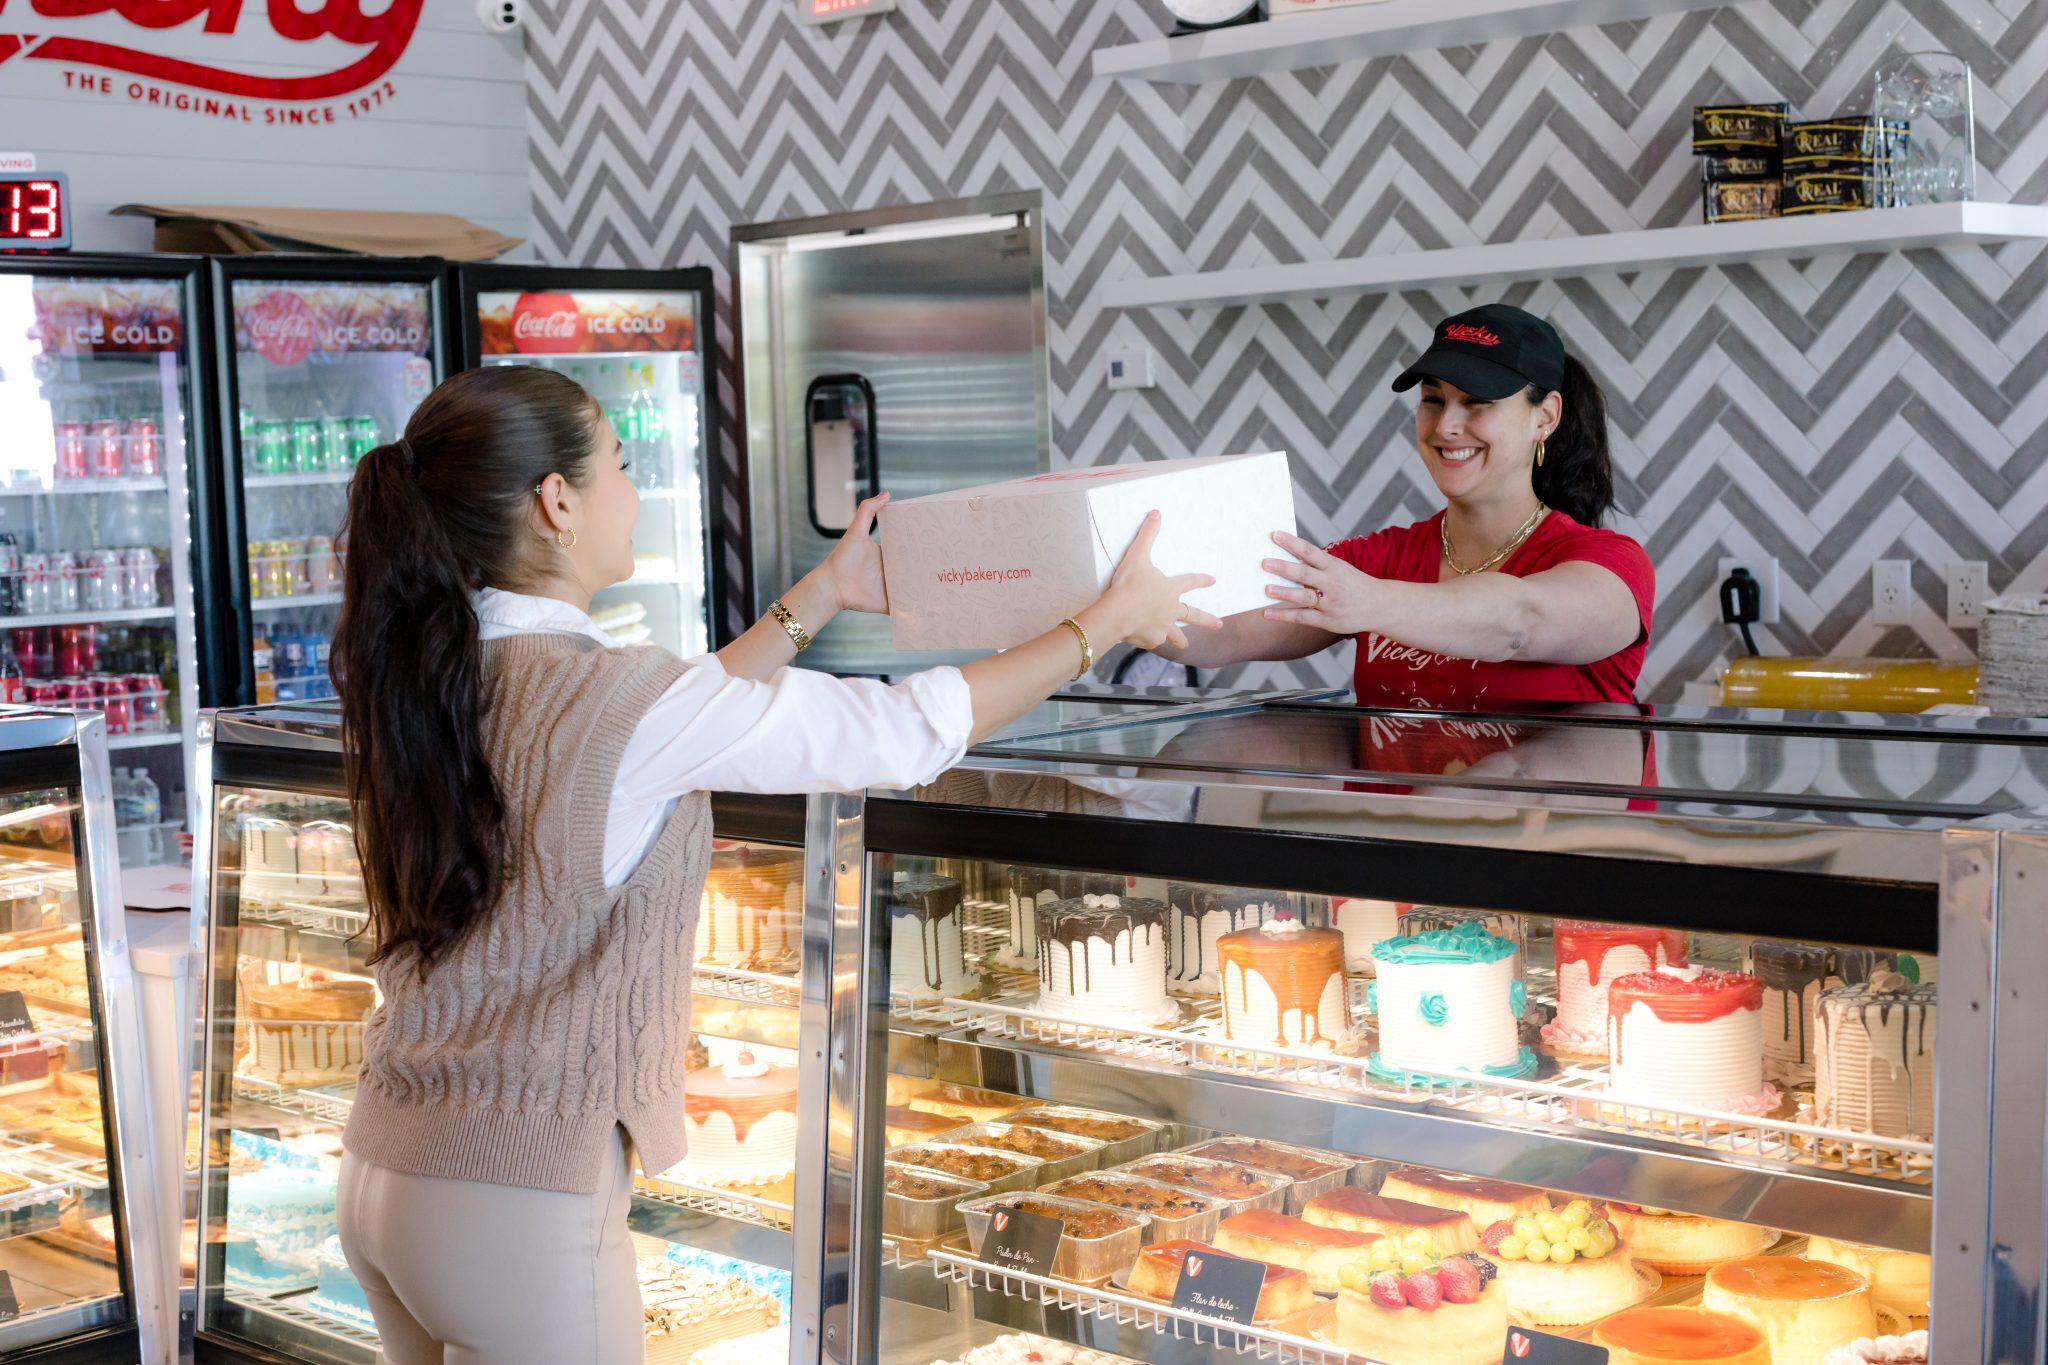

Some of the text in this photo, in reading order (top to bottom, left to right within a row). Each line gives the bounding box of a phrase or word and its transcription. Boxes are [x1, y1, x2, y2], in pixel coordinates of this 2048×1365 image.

[63, 71, 397, 124] THE ORIGINAL SINCE 1972
[1704, 115, 1754, 136] REAL
[1795, 132, 1842, 153] REAL
[1796, 181, 1842, 202] REAL
[12, 183, 57, 237] 13
[66, 326, 173, 344] ICE COLD
[587, 317, 666, 333] ICE COLD
[327, 327, 421, 345] ICE COLD
[937, 566, 1031, 585] vickybakery.com
[1367, 632, 1433, 671] Vicky
